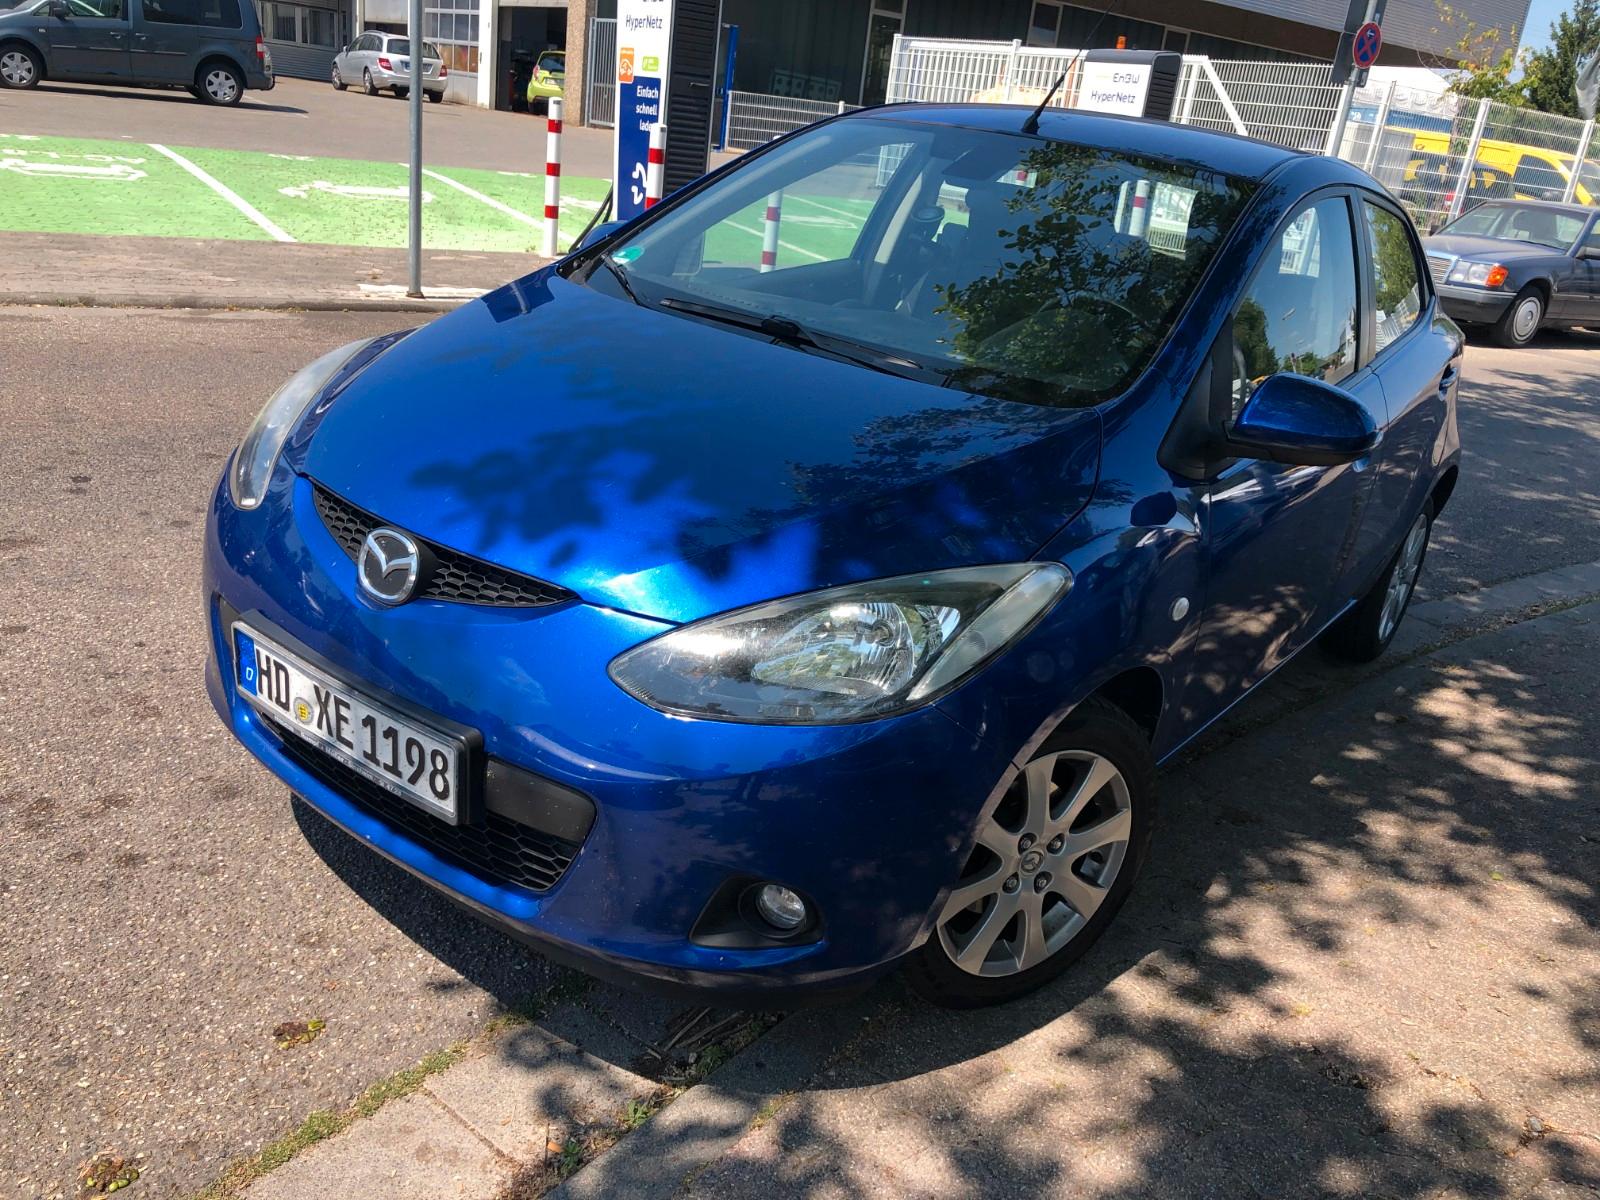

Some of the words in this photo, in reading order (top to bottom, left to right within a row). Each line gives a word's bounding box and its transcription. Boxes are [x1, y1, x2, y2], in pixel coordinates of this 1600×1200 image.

[625, 14, 663, 31] HyperNetz
[1113, 72, 1140, 84] EnBW
[636, 85, 659, 99] Einfach
[1091, 90, 1136, 104] HyperNetz
[635, 102, 658, 116] schnell
[245, 667, 254, 681] D
[256, 648, 290, 712] HD
[313, 683, 354, 750] XE
[361, 714, 450, 801] 1198
